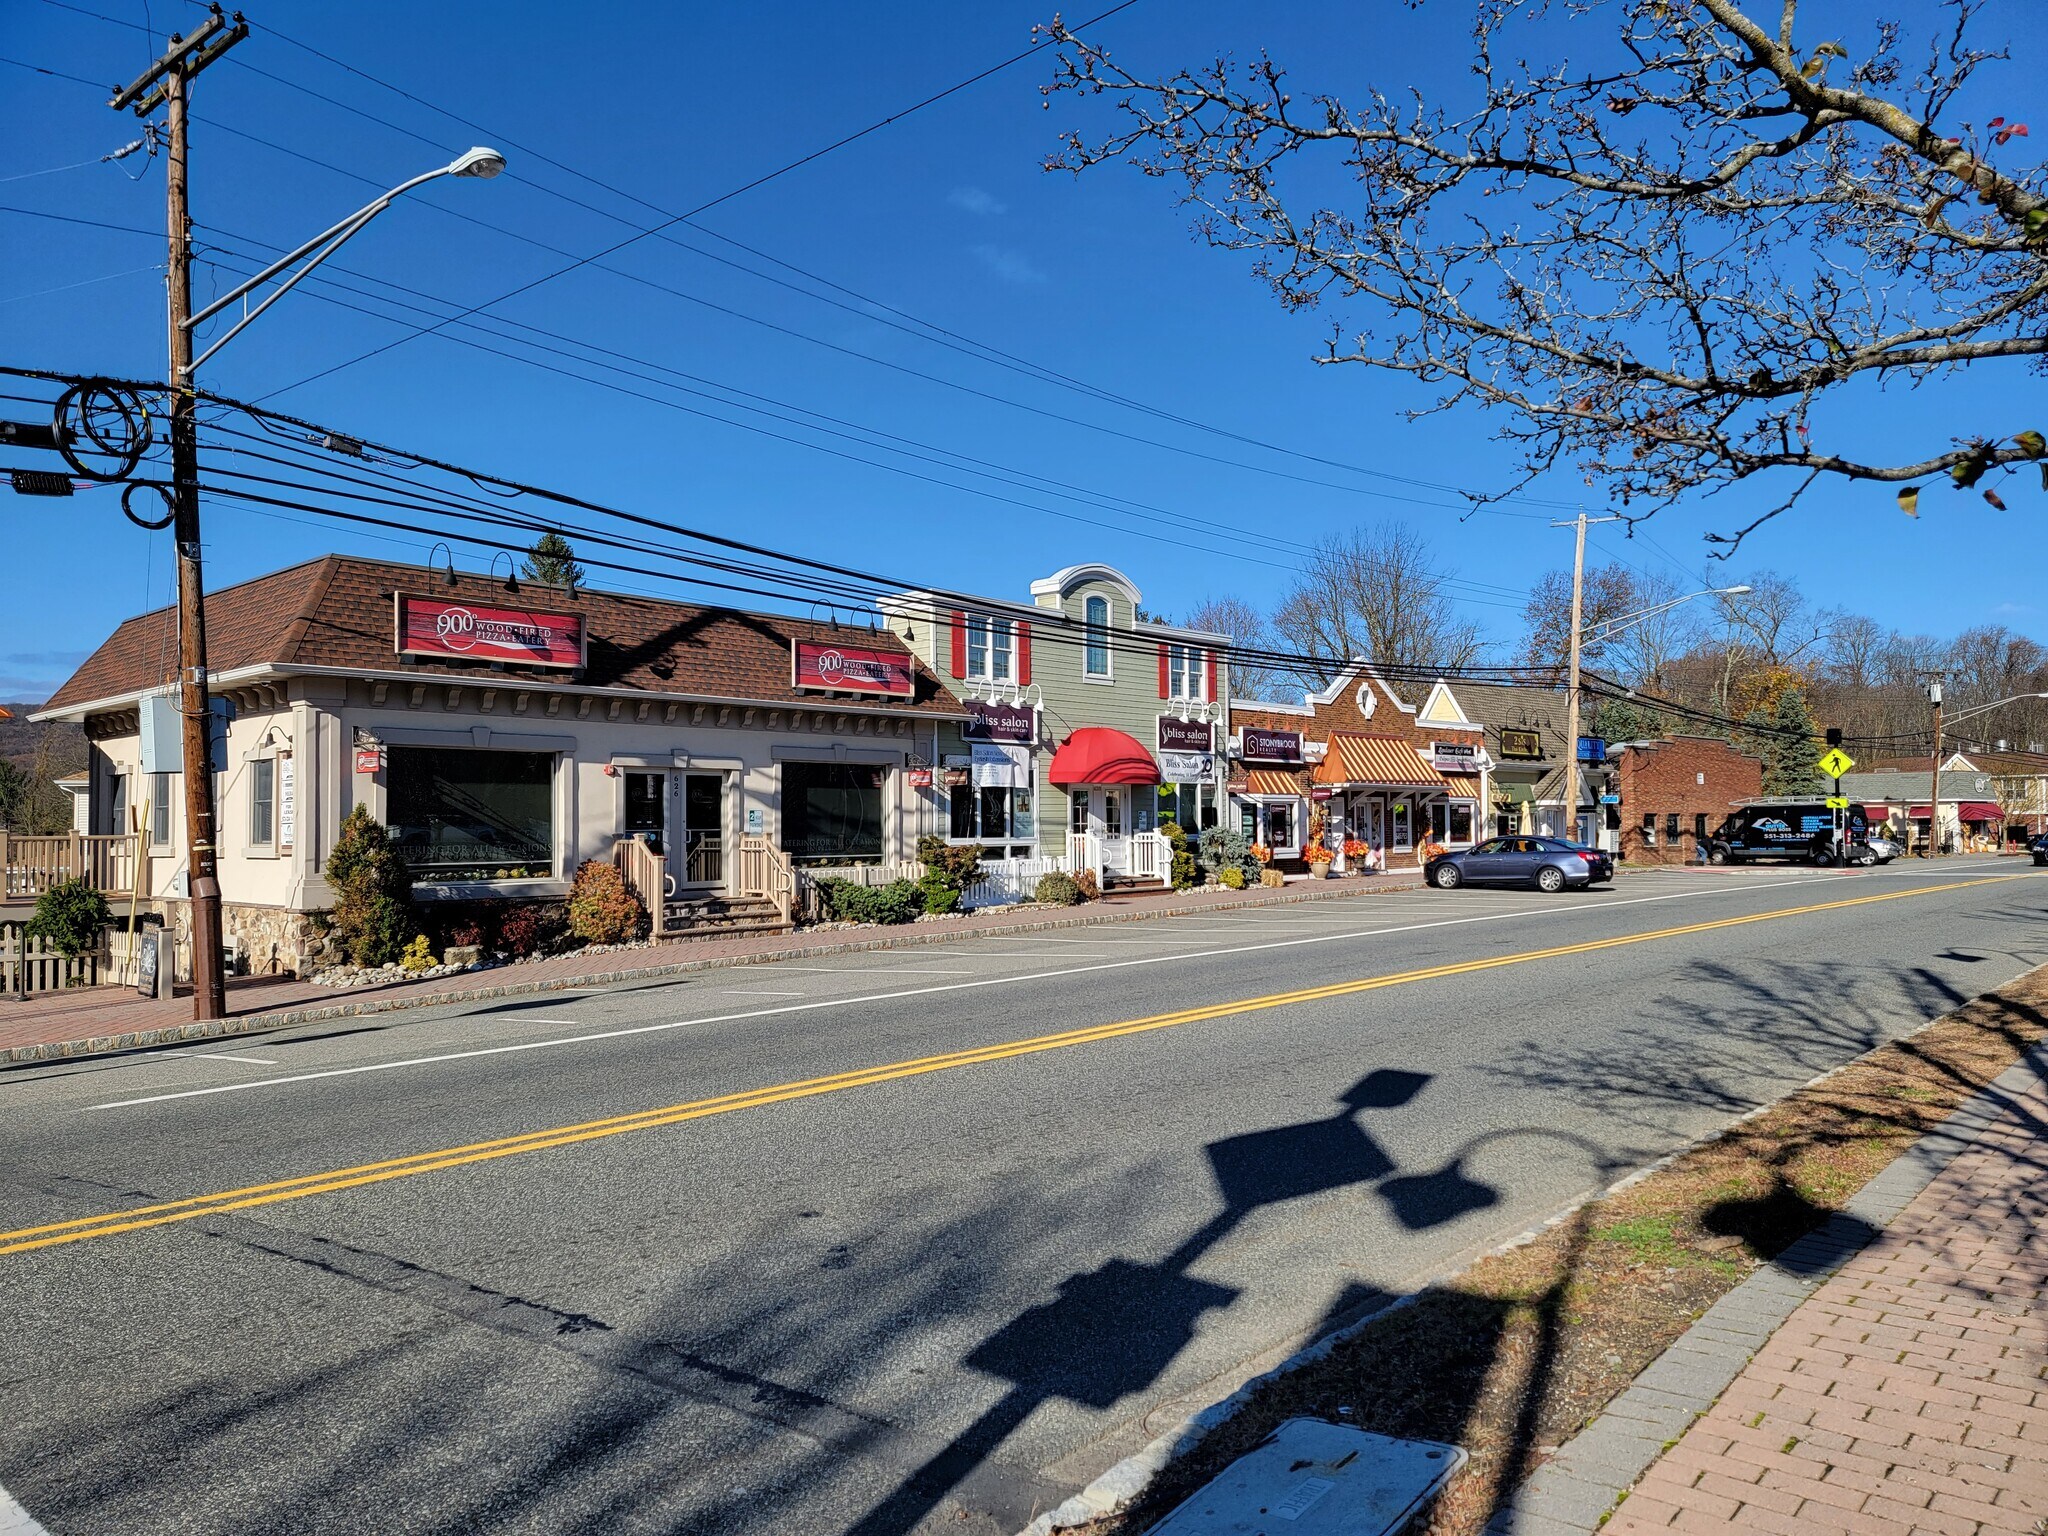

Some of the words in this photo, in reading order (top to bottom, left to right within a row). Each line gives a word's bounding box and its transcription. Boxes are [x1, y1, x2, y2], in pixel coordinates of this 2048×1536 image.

[1001, 715, 1029, 728] salon
[1167, 726, 1186, 739] bliss
[1186, 729, 1208, 740] salon
[1259, 738, 1296, 749] STONYBROOK
[1165, 758, 1181, 769] Bliss
[1182, 760, 1199, 769] Salon
[1201, 758, 1213, 773] 10
[1278, 1482, 1326, 1514] TRAFFIC
